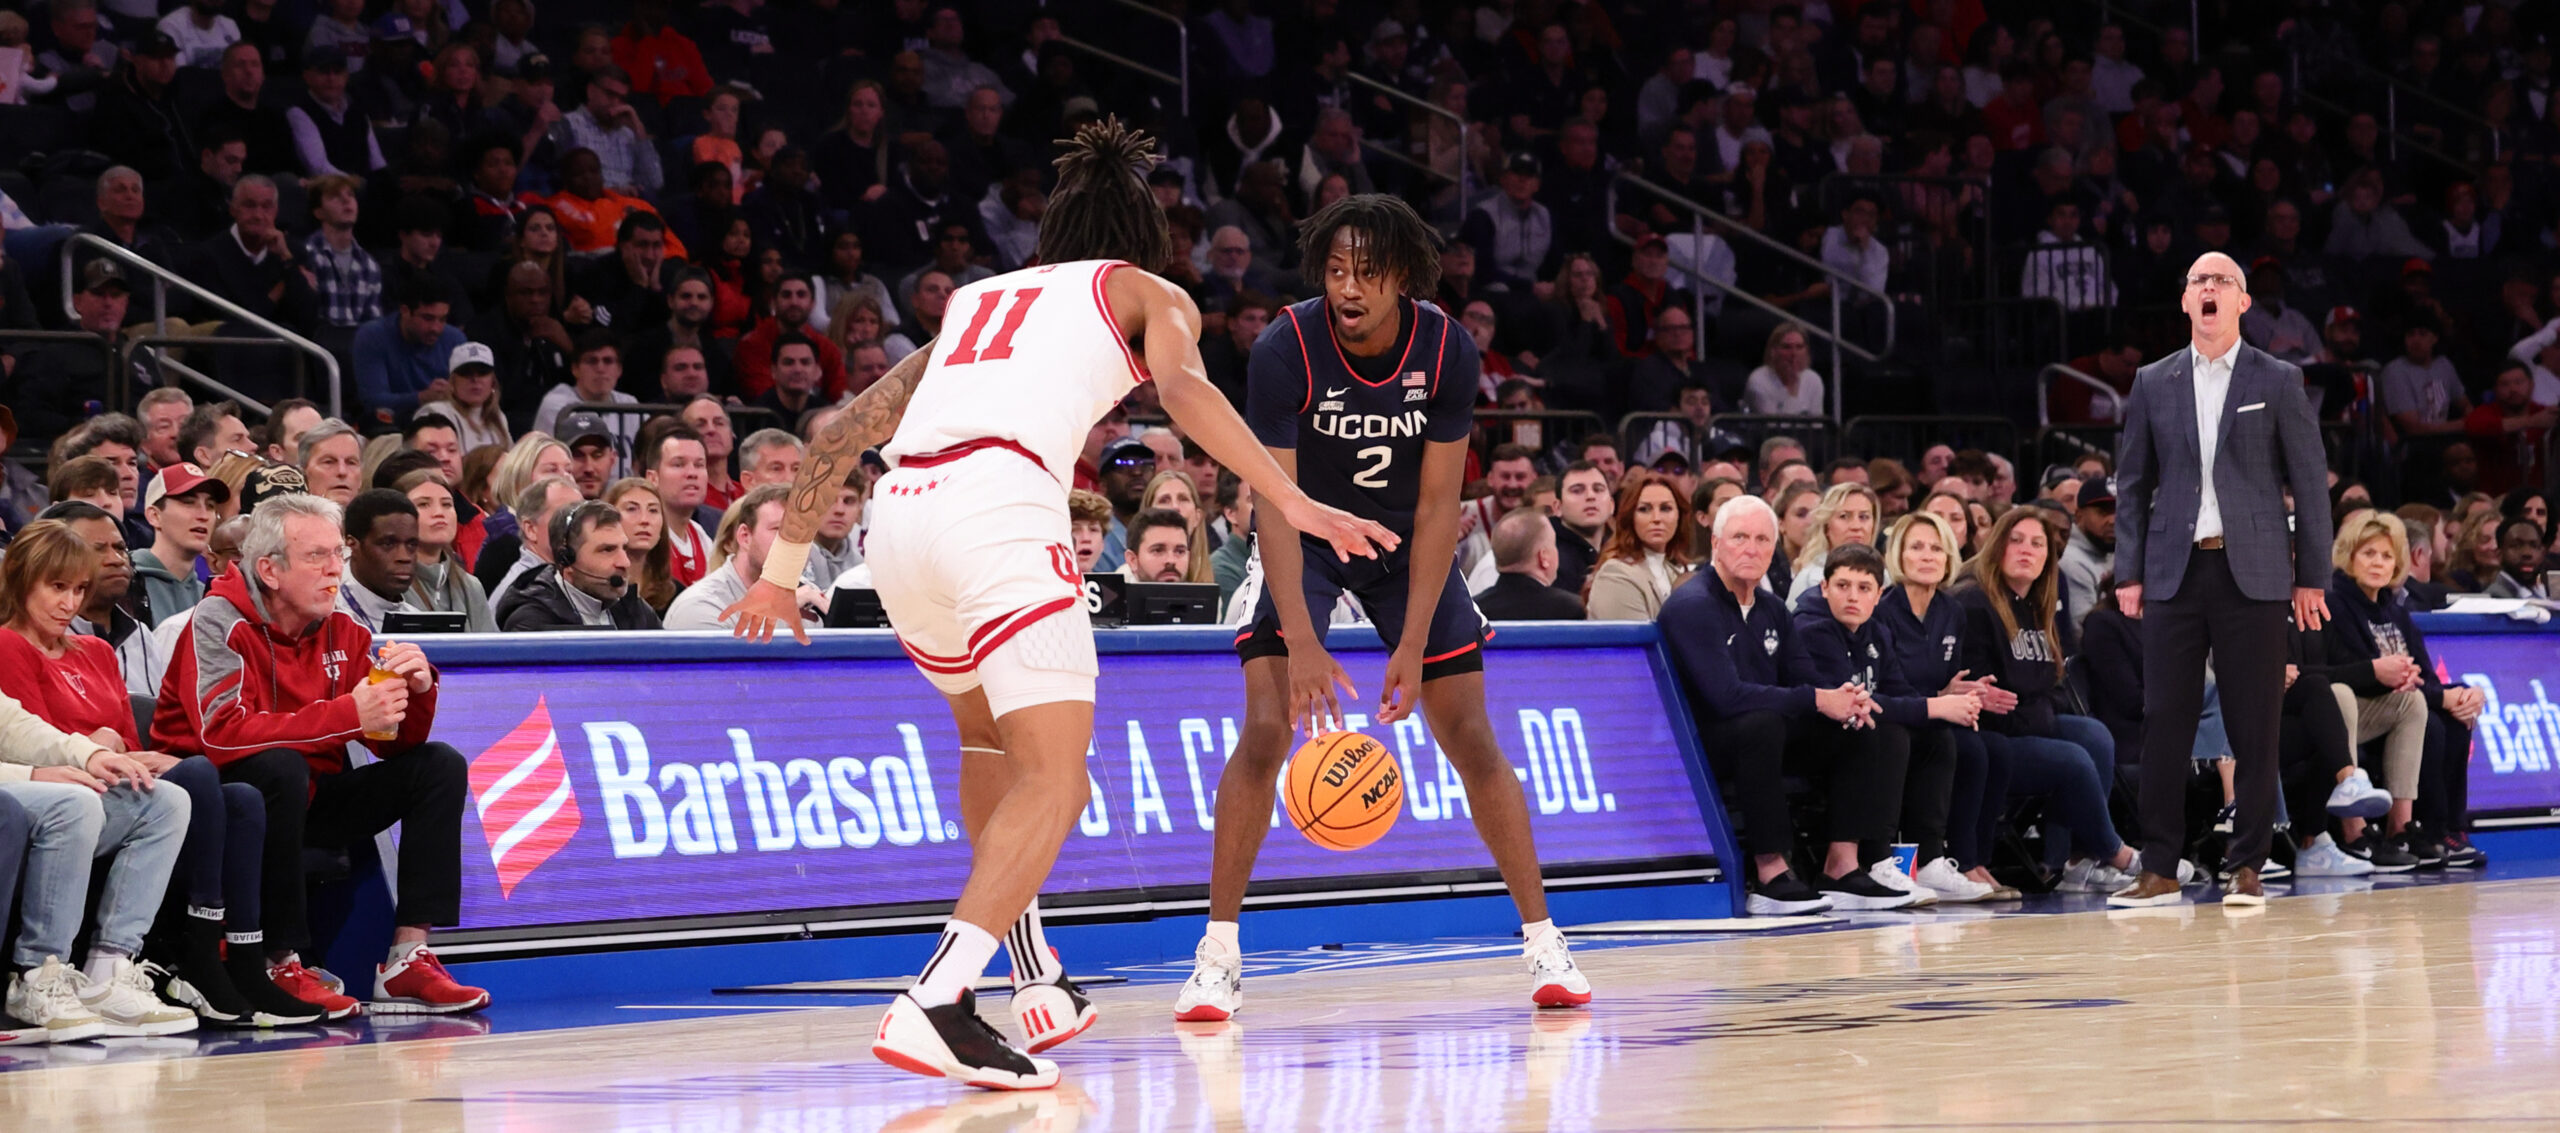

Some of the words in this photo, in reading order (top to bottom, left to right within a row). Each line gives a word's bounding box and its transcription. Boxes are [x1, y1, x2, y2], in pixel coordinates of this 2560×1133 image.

[944, 286, 1044, 367] 11
[1352, 445, 1393, 489] 2
[1322, 739, 1380, 788] Wilson
[1361, 766, 1398, 810] NCAA
